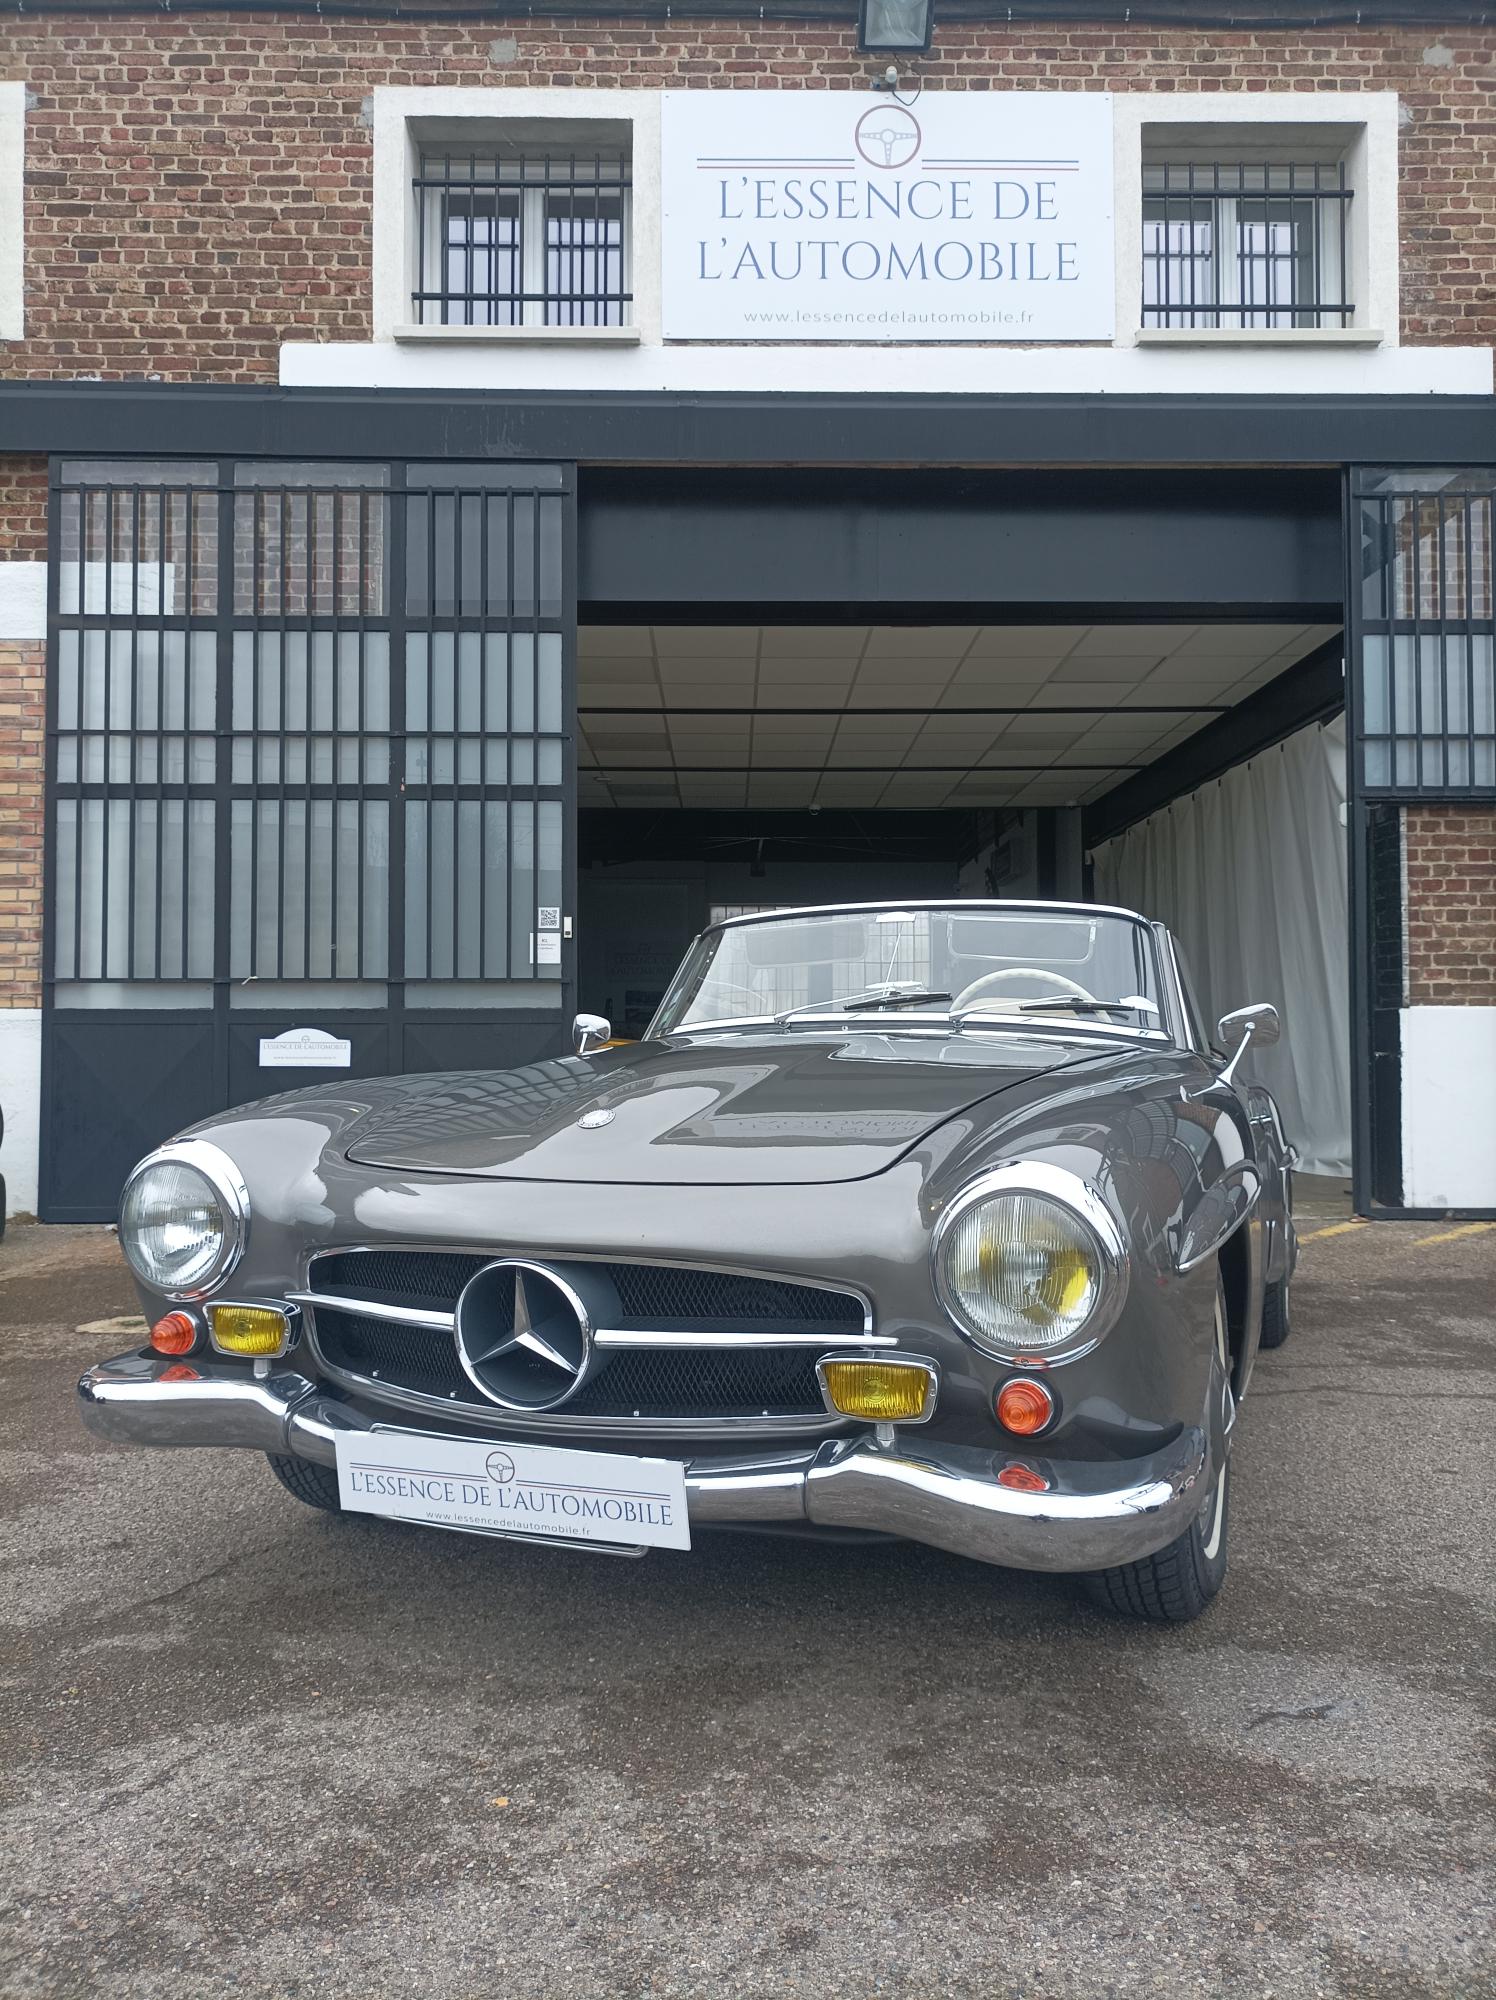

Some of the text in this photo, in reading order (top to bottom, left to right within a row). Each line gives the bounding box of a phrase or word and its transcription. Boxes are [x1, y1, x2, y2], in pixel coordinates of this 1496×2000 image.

[718, 176, 1059, 220] L'ESSENCE DE
[697, 237, 1080, 281] L'AUTOMOBILE
[743, 309, 1034, 325] www.lessencedelautomobile.fr
[350, 1472, 673, 1527] L'ESSENCE DE L'AUTOMOBILE
[425, 1510, 591, 1536] www.lessencedelautomobile.fr
